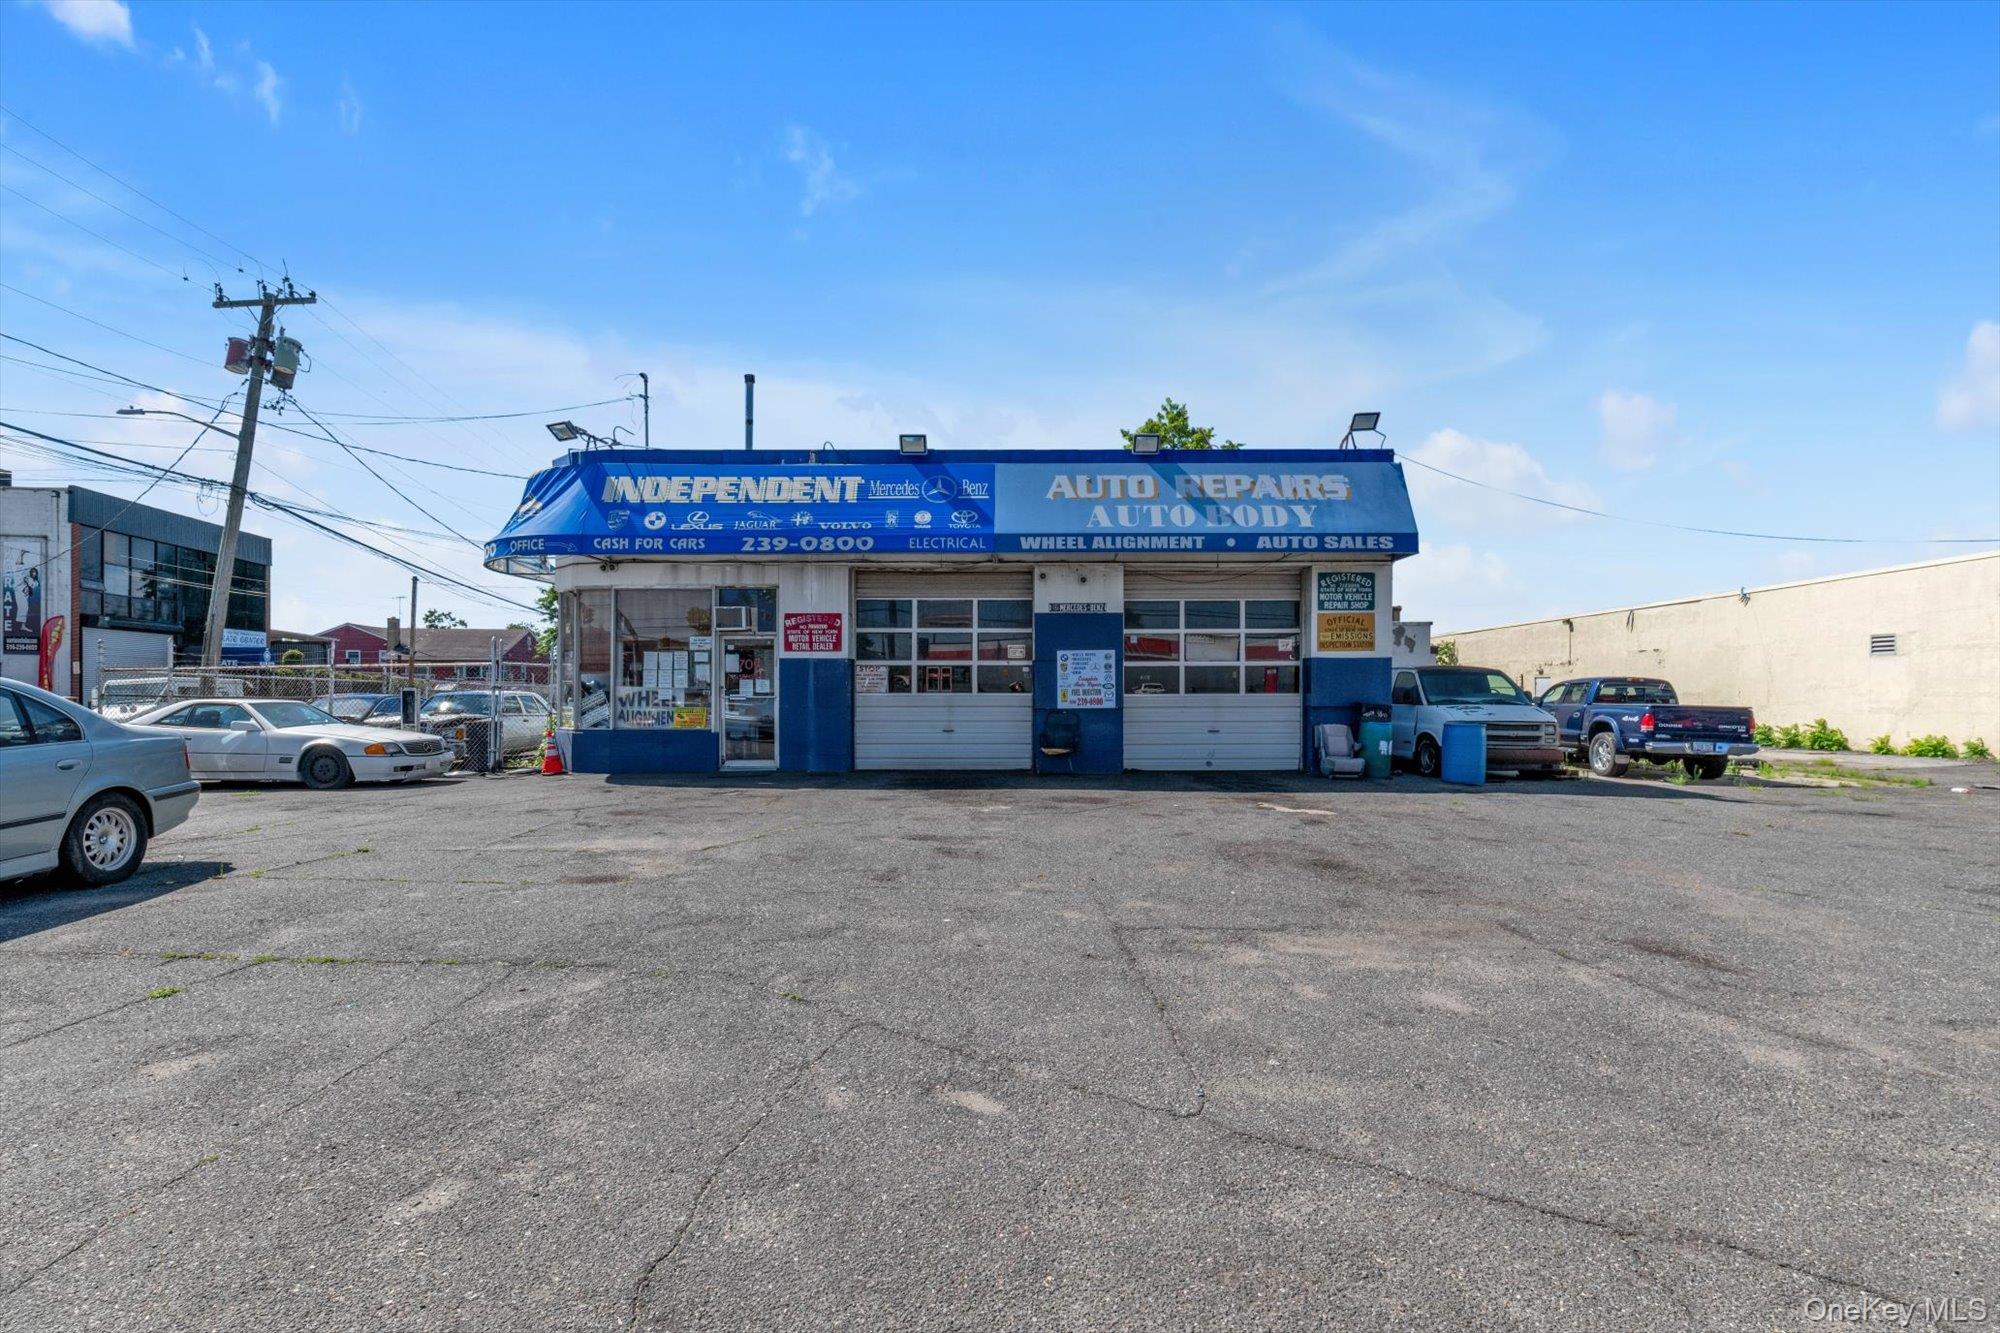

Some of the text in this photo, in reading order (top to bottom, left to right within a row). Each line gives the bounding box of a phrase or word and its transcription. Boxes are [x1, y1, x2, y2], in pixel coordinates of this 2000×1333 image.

[602, 476, 864, 503] INDEPENDENT
[869, 479, 988, 496] Mercedes Benz
[1046, 475, 1352, 500] AUTO REPAIRS
[1086, 504, 1317, 528] AUTO BODY
[671, 523, 723, 531] LEXUS
[734, 520, 776, 529] JAGUAR
[818, 521, 872, 530] VOLVO
[510, 539, 545, 552] OFFICE
[593, 537, 706, 550] CASH FOR CARS
[741, 536, 874, 552] 239-0800
[909, 537, 987, 549] ELECTRICAL
[1019, 536, 1206, 550] WHEEL ALIGNMENT
[1256, 535, 1394, 549] AUTO SALES
[1320, 573, 1372, 587] REGISTERED
[1320, 593, 1373, 601] MOTOR VEHICLE
[1324, 601, 1369, 609] REPAIR SHOP
[784, 614, 841, 627] REGISTERD
[1327, 615, 1365, 626] OFFICIAL
[788, 634, 837, 642] MOTOR VEHICLE
[1330, 632, 1373, 640] EMISSIONS
[812, 642, 833, 650] DEALER
